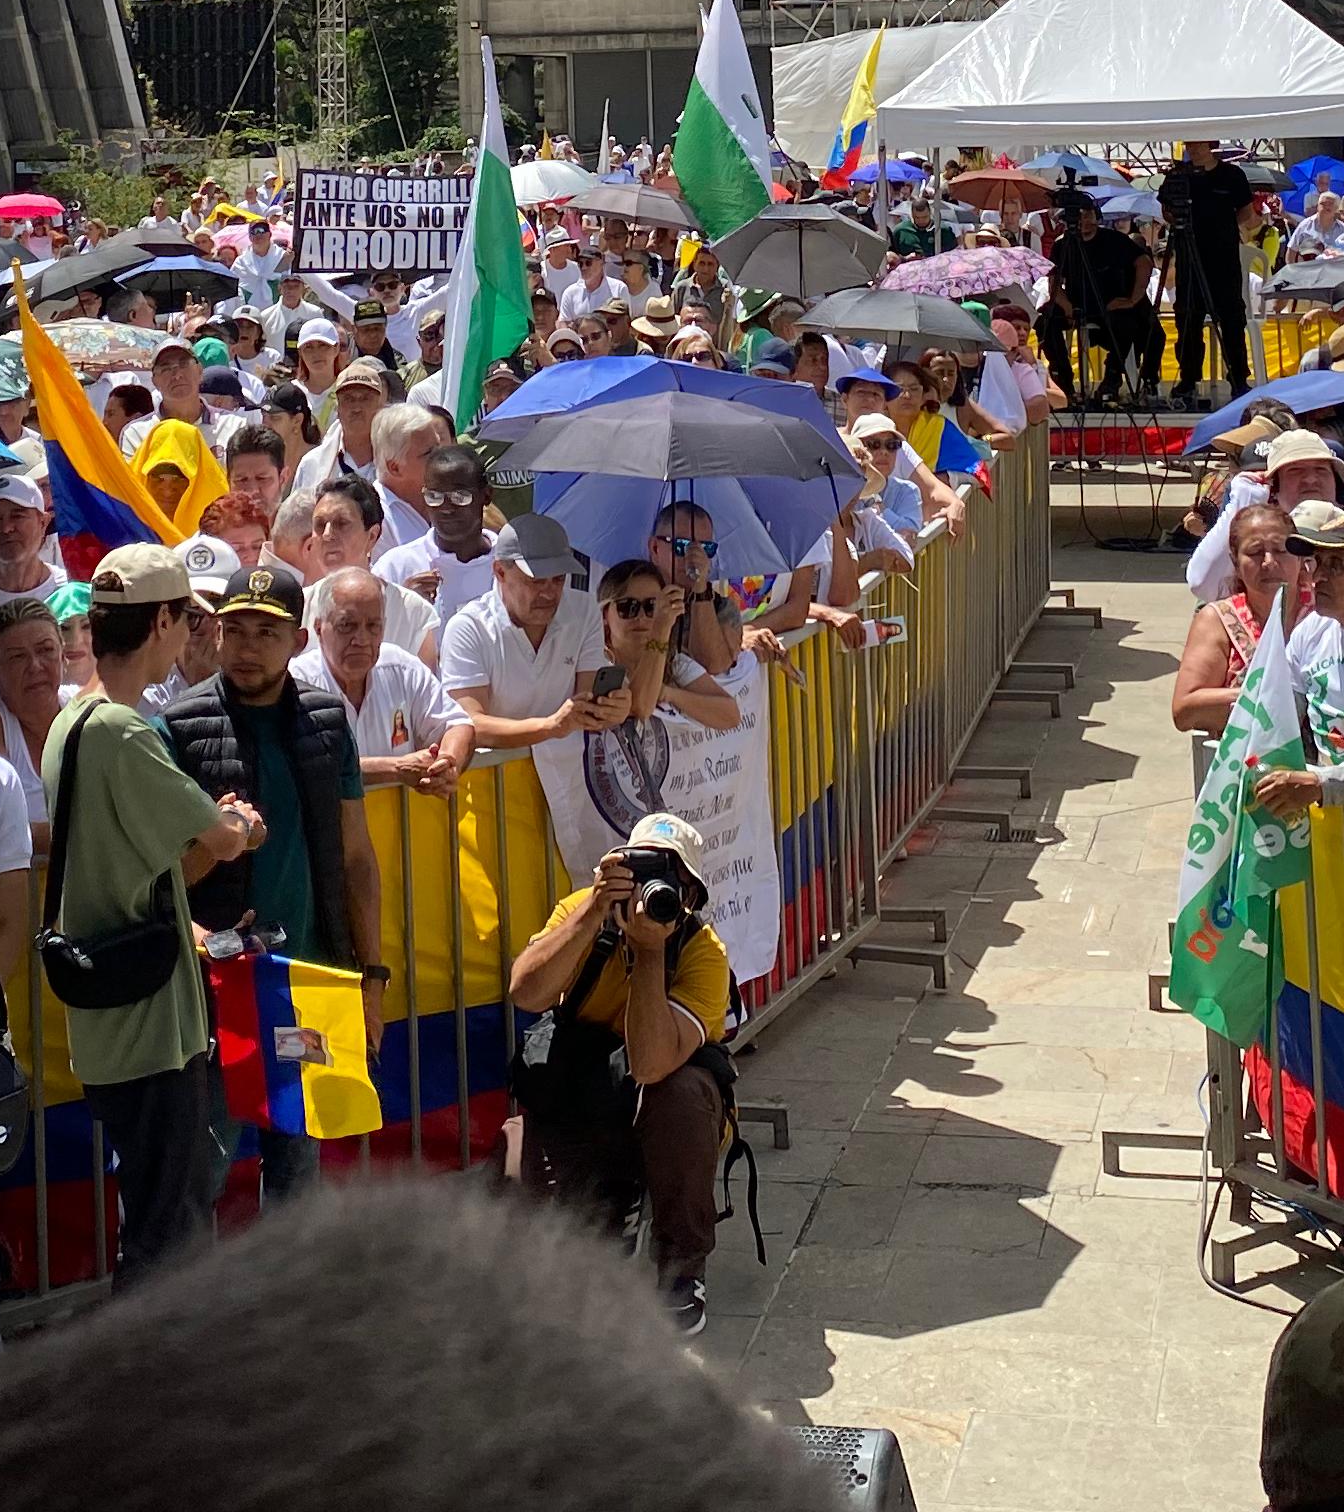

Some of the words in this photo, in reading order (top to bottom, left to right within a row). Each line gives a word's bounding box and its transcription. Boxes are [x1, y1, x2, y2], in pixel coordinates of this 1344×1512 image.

[301, 172, 368, 201] PETRO
[303, 202, 356, 228] ANTE
[364, 204, 407, 228] VOS
[417, 206, 444, 228] NO
[298, 229, 462, 270] ARRODILL
